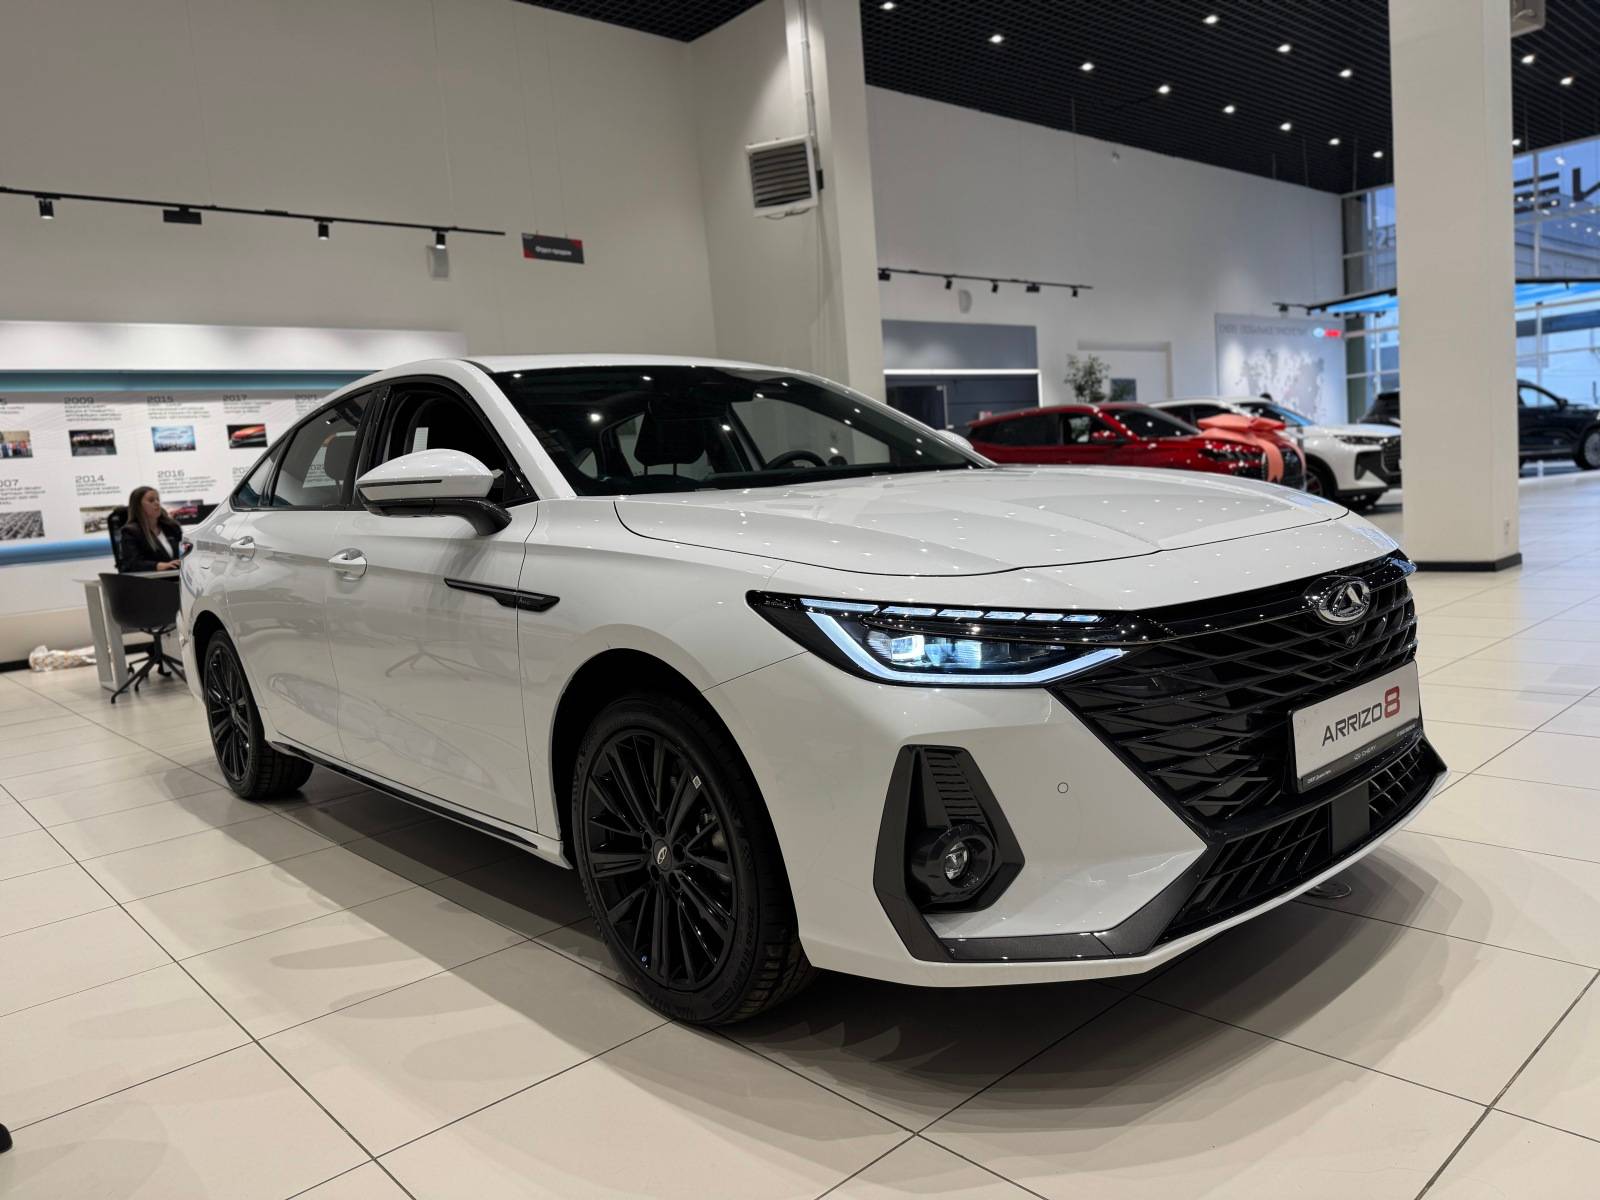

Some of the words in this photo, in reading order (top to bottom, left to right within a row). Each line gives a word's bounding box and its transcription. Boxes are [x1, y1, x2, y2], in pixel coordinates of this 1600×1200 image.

[147, 395, 174, 403] 2015
[157, 470, 185, 478] 2016
[75, 475, 105, 483] 2014
[1322, 702, 1382, 747] ARRIZO
[1384, 686, 1400, 718] 8
